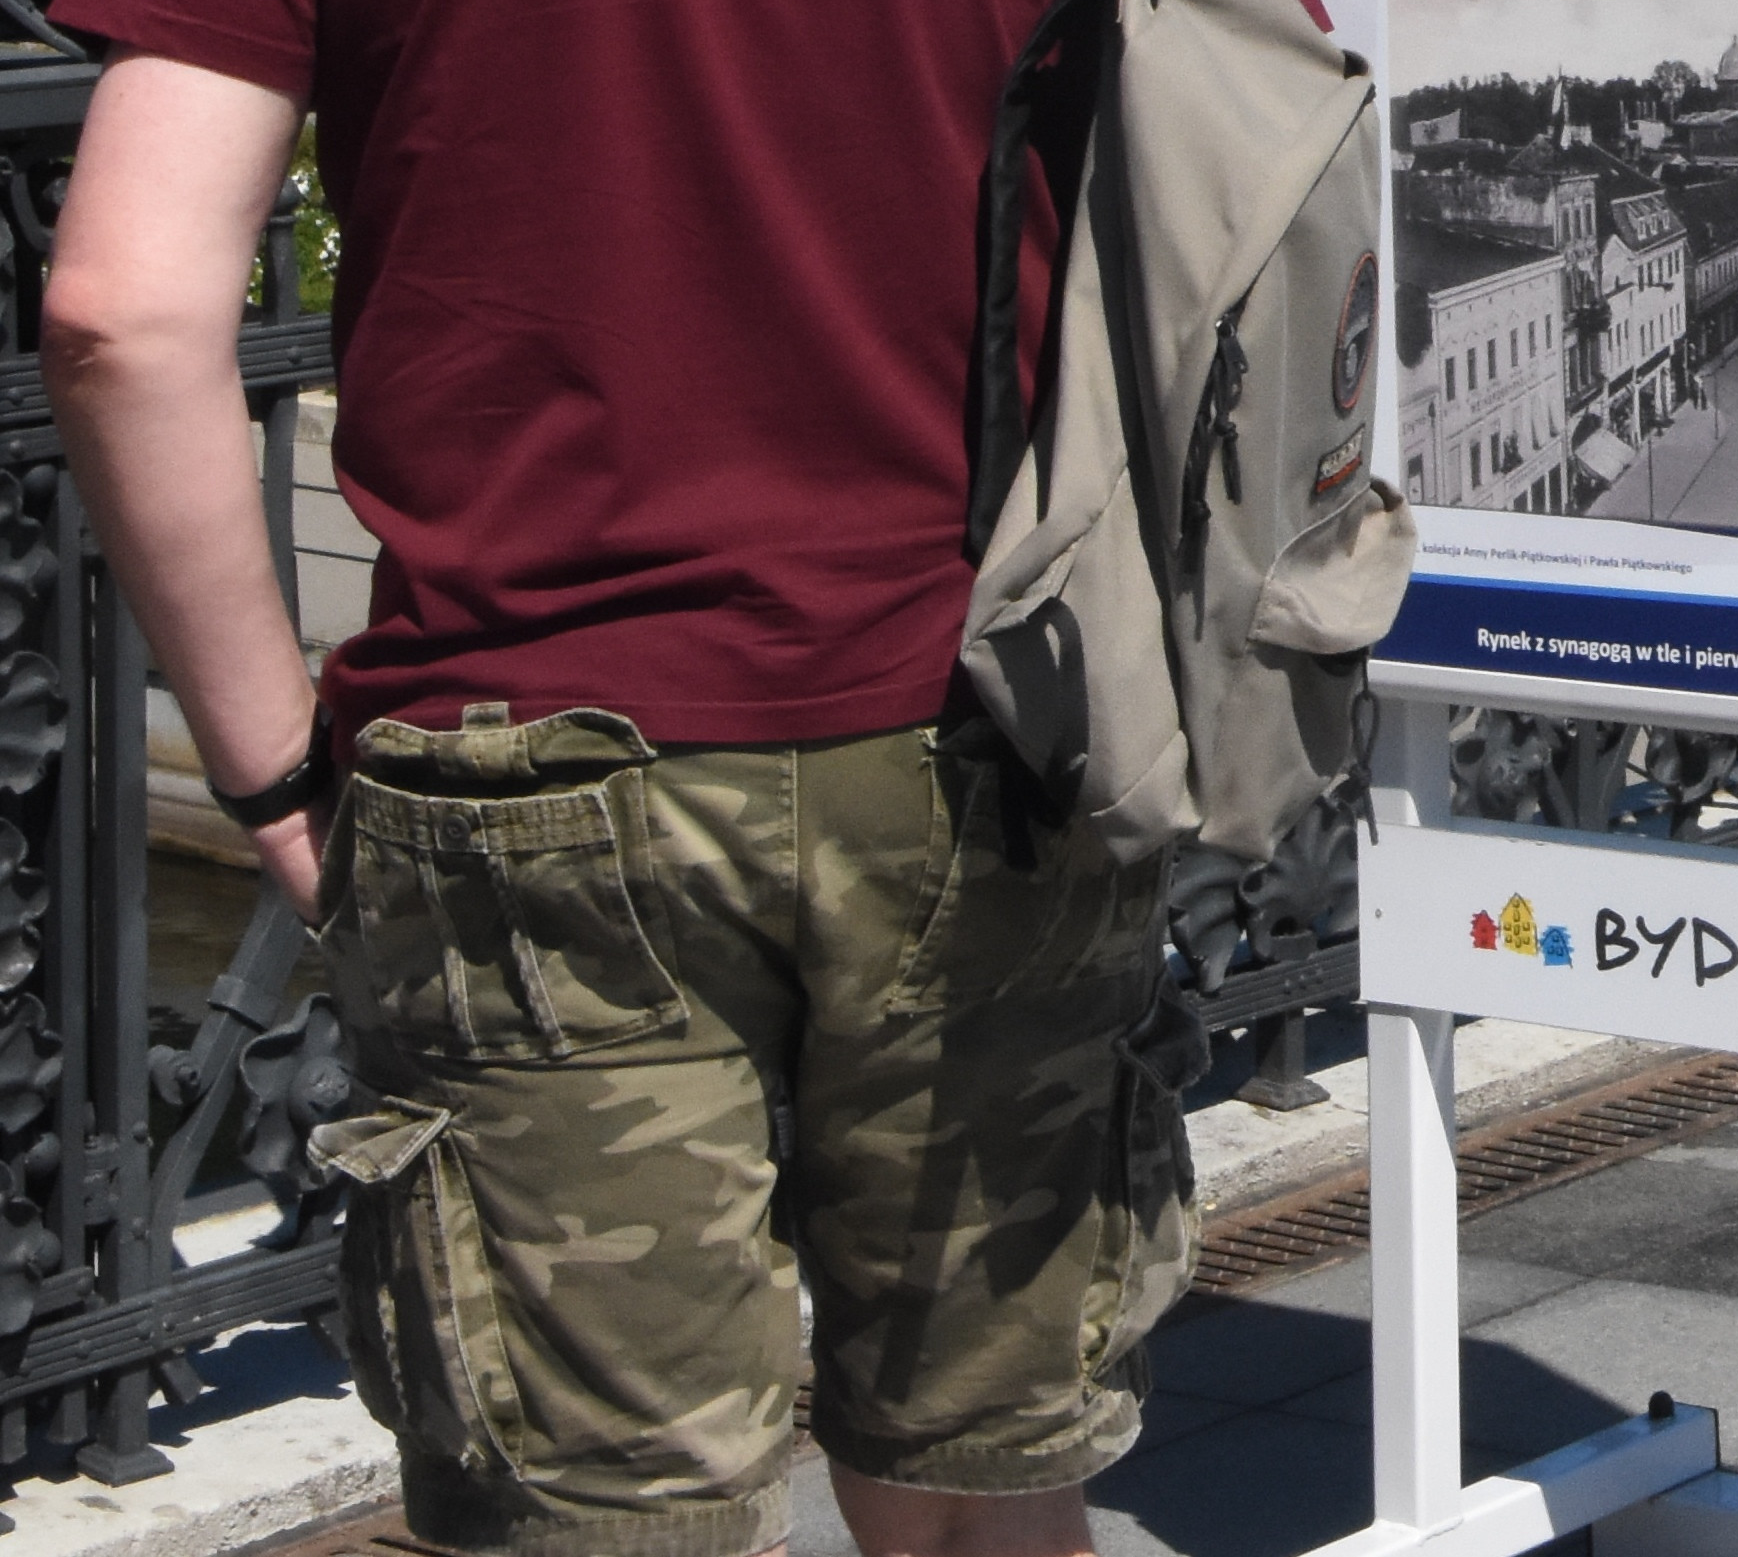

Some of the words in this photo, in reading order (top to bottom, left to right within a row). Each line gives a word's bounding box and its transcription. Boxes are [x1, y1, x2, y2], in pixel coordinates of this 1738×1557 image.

[1476, 627, 1532, 652] Rynek
[1534, 636, 1545, 652] z
[1547, 637, 1632, 664] synagogą
[1634, 645, 1653, 661] w
[1654, 642, 1682, 663] tle
[1684, 644, 1691, 664] i
